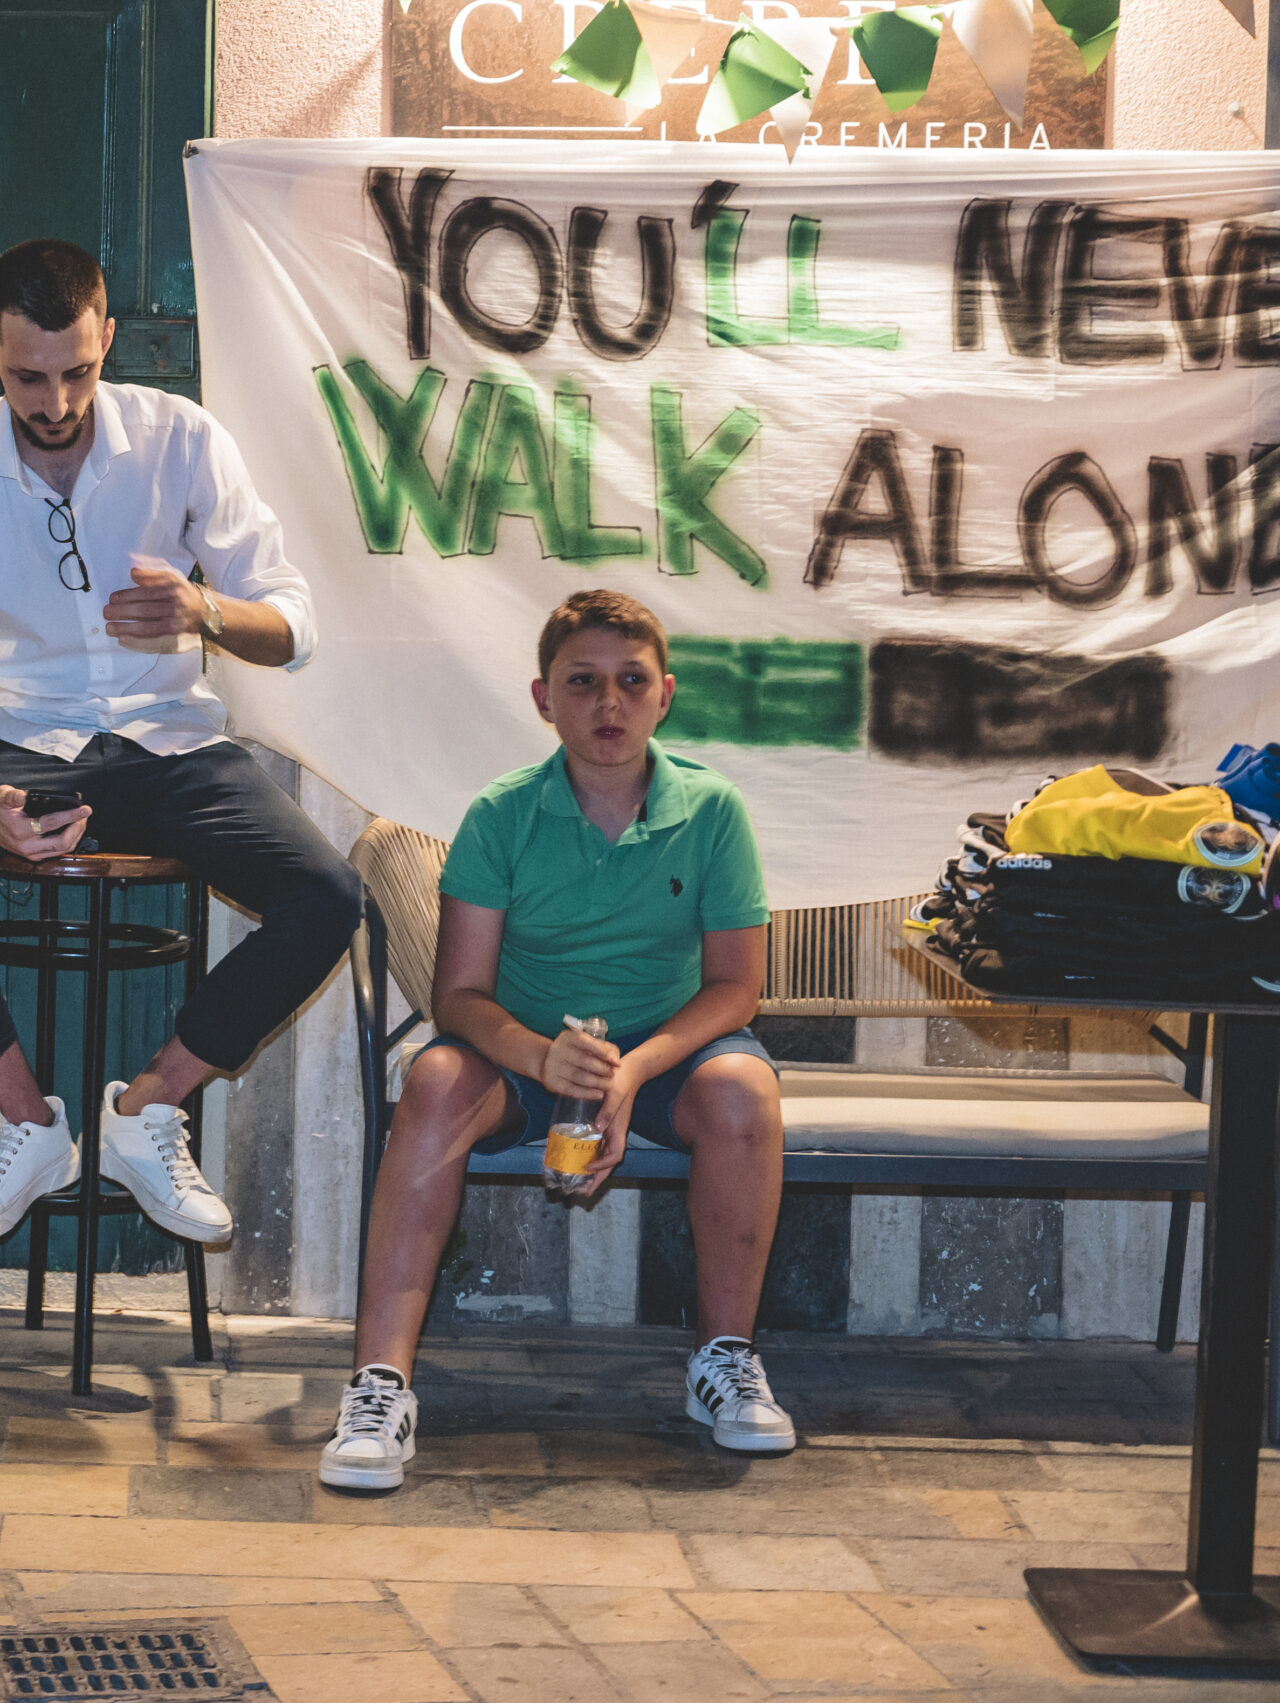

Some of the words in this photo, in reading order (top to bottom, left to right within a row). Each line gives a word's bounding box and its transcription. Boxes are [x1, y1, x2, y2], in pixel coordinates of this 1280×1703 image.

[365, 165, 902, 361] YOU'LL
[312, 357, 768, 588] WALK
[997, 855, 1052, 870] adidas
